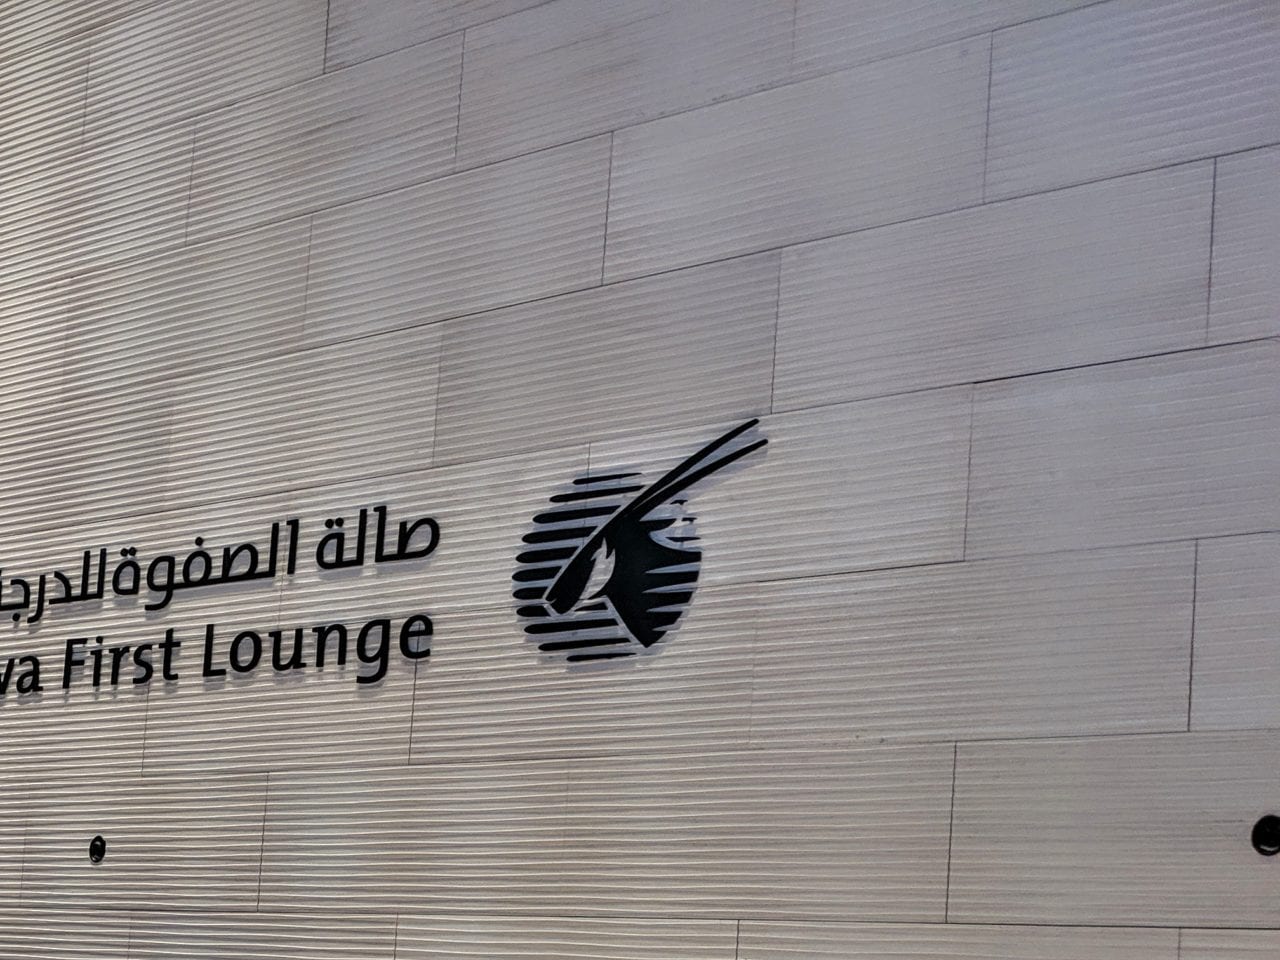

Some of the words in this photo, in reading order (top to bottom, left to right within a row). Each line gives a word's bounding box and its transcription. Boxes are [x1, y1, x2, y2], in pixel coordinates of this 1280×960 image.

[111, 519, 300, 612] الصفوة
[315, 506, 441, 571] صالة
[62, 628, 182, 690] First
[203, 614, 434, 685] Lounge
